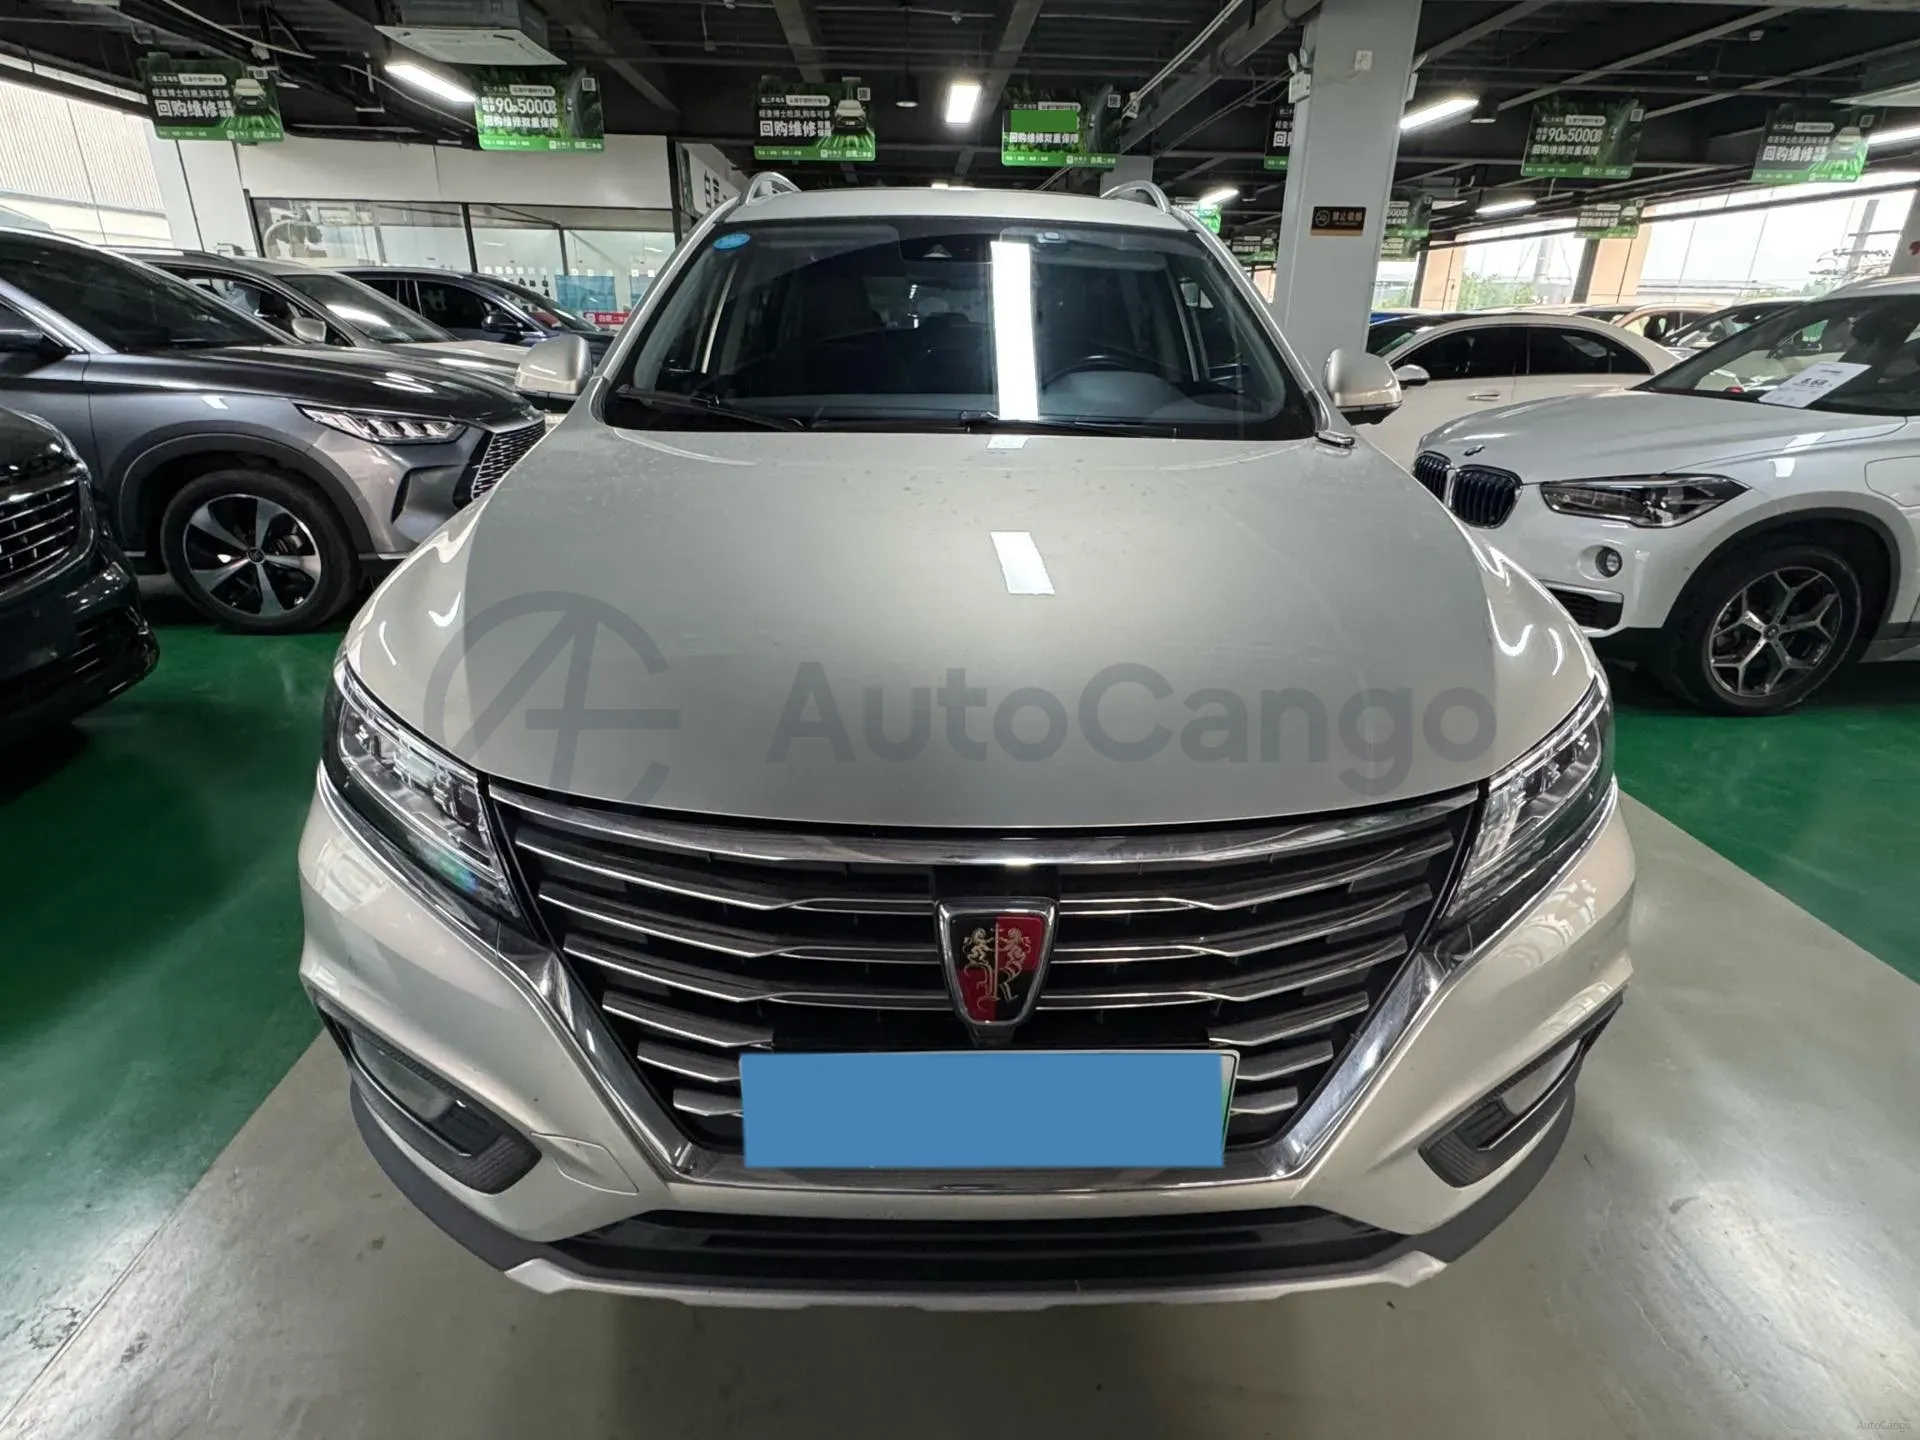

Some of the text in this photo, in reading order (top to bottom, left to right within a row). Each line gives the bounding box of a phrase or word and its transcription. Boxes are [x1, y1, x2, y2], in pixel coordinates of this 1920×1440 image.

[155, 99, 218, 117] 回购维修
[760, 120, 816, 137] 回购维修
[1762, 145, 1813, 162] 回购维修
